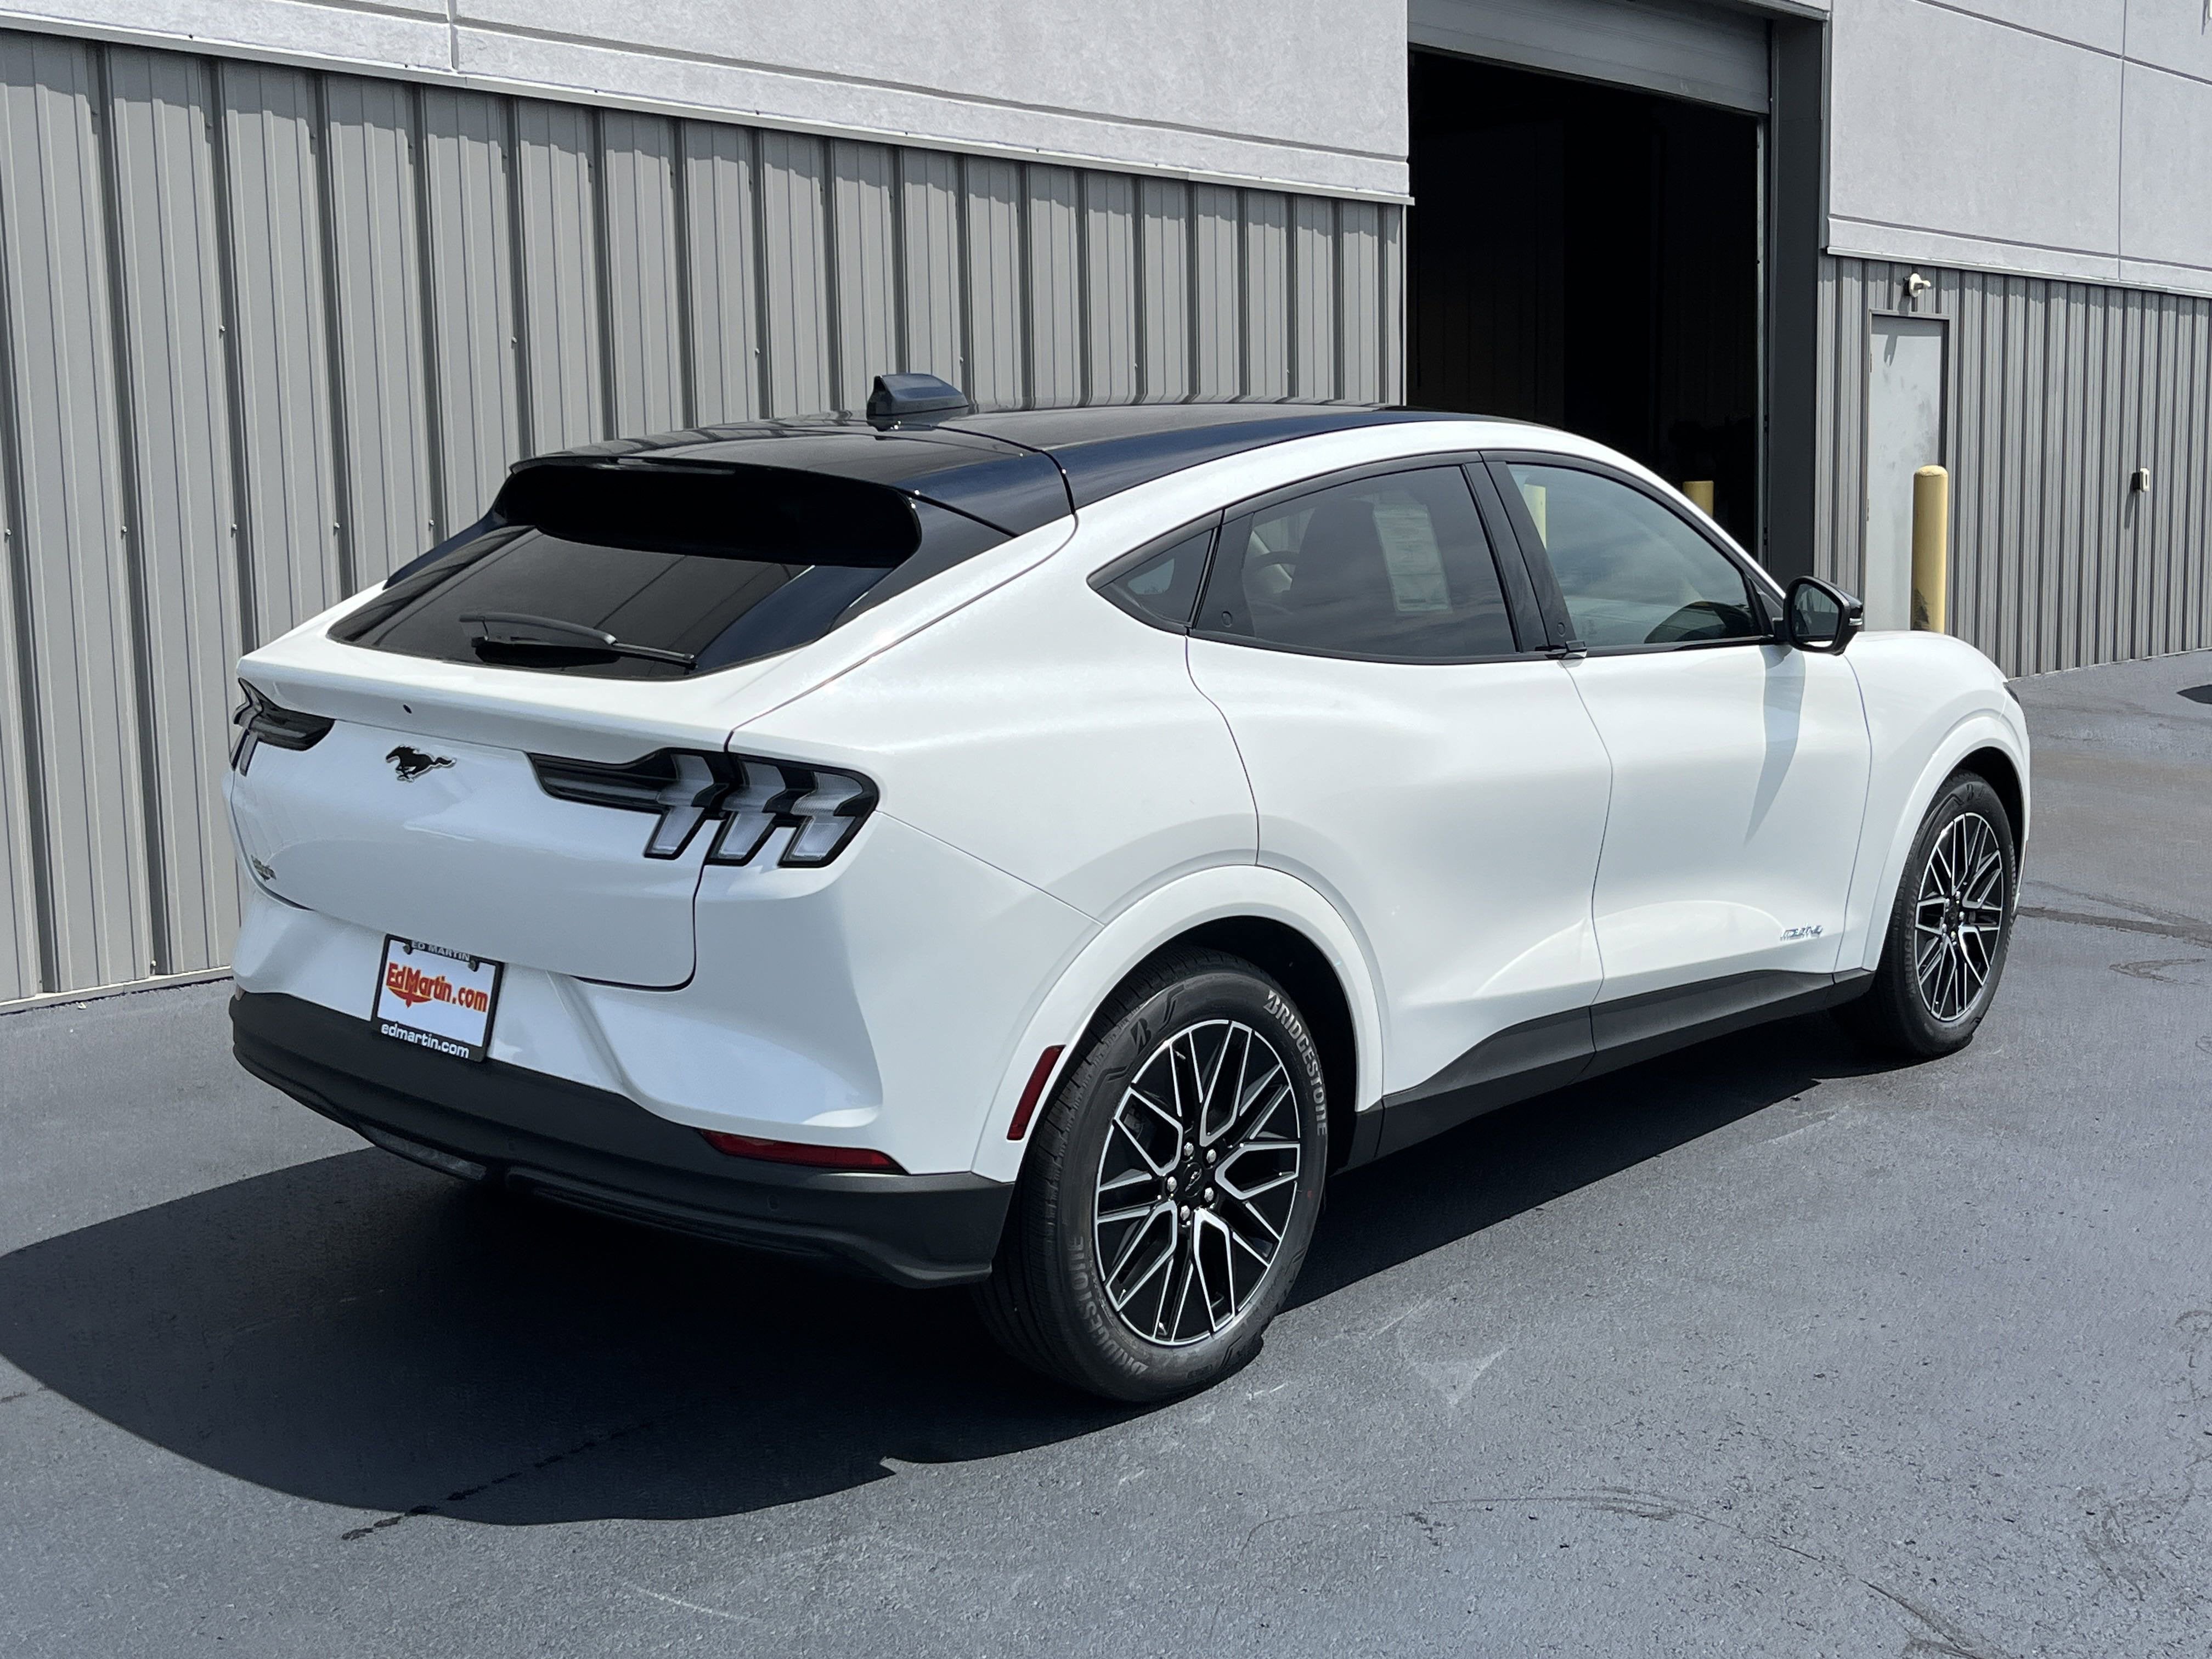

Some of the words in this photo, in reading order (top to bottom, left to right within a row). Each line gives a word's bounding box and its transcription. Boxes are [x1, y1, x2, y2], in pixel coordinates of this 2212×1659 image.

[411, 940, 426, 950] ED
[428, 945, 470, 961] MARTIN
[386, 962, 488, 1012] EdMartin.com
[381, 1023, 470, 1058] edmartin.com
[1263, 990, 1327, 1136] BRIDGESTONE
